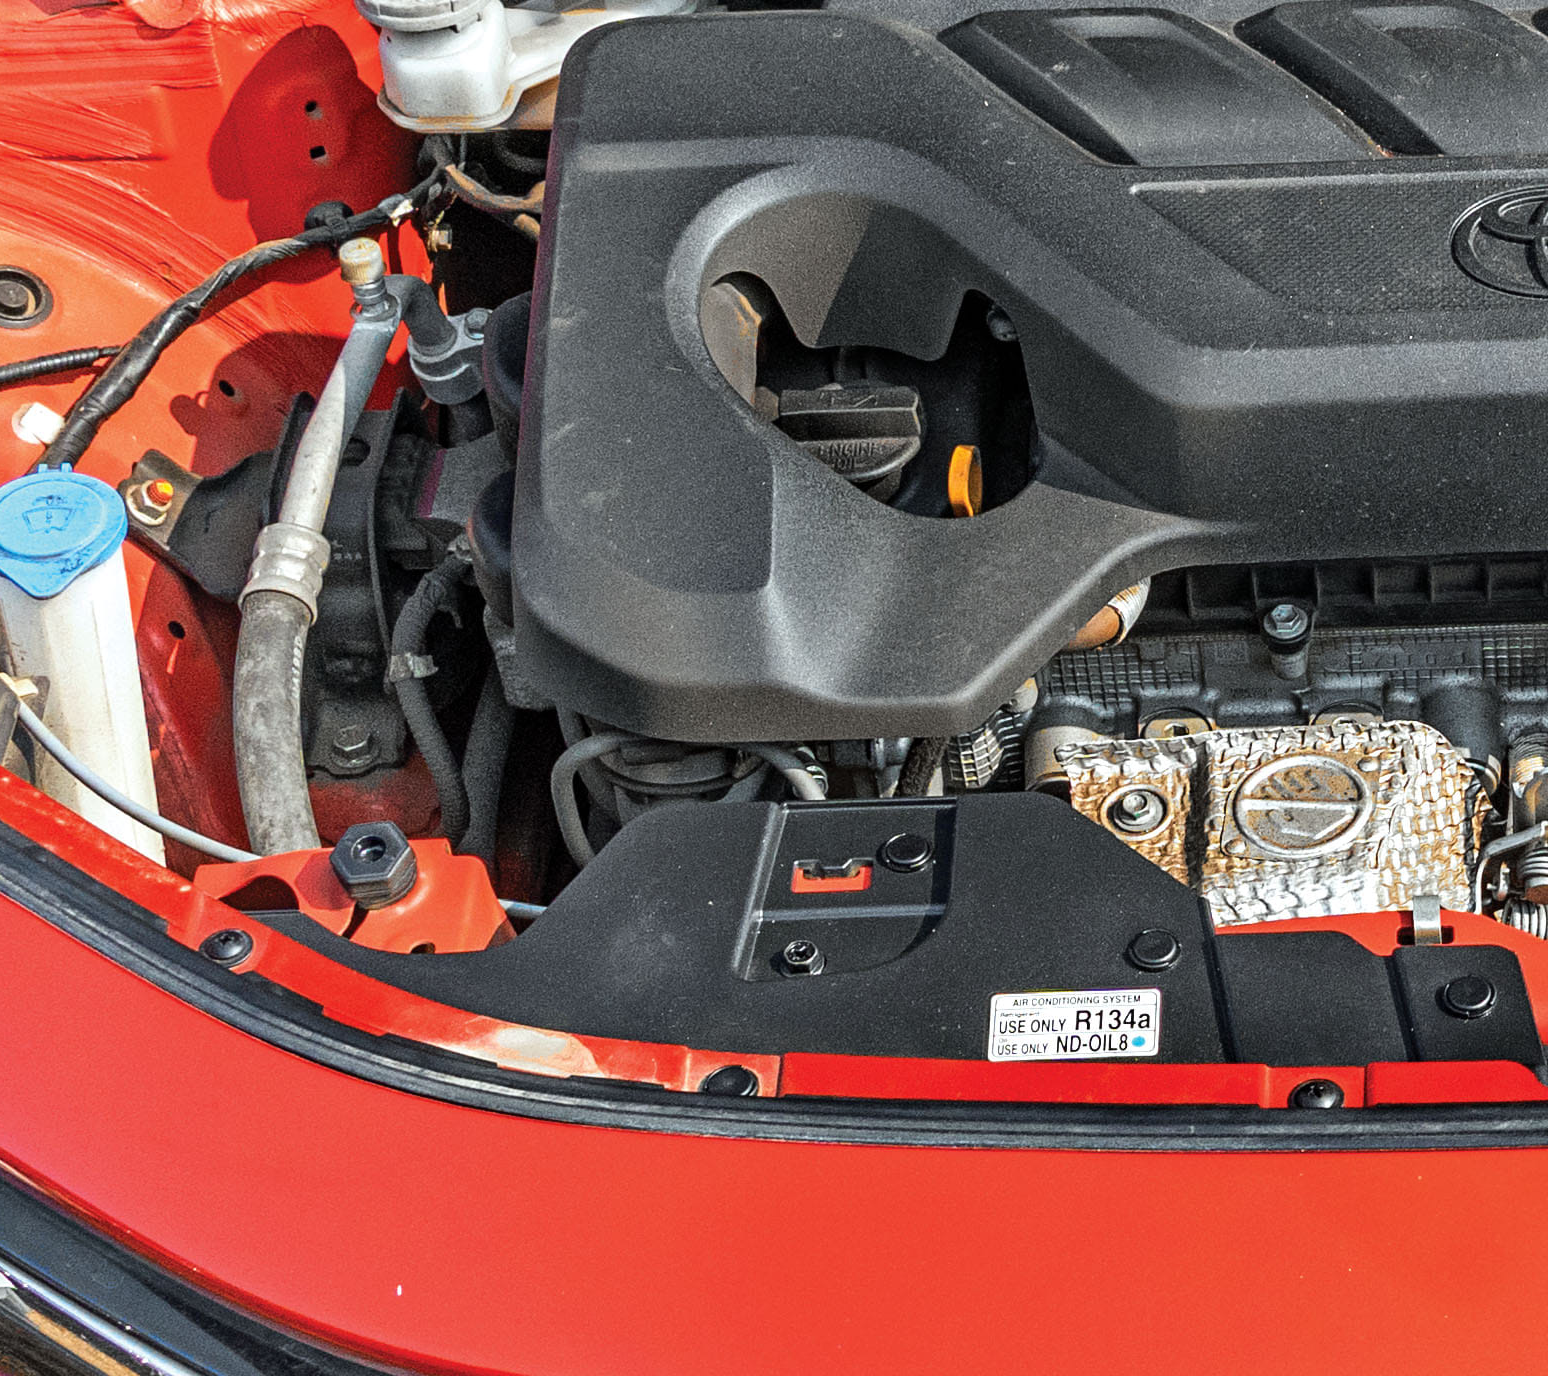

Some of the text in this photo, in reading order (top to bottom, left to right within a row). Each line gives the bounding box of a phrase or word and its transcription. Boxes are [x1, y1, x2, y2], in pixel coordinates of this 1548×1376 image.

[1013, 994, 1141, 1007] AIR CONDITIONING SYSTEM
[999, 1009, 1151, 1034] USE ONLY R134a
[997, 1034, 1128, 1056] USE ONLY ND-OIL8
